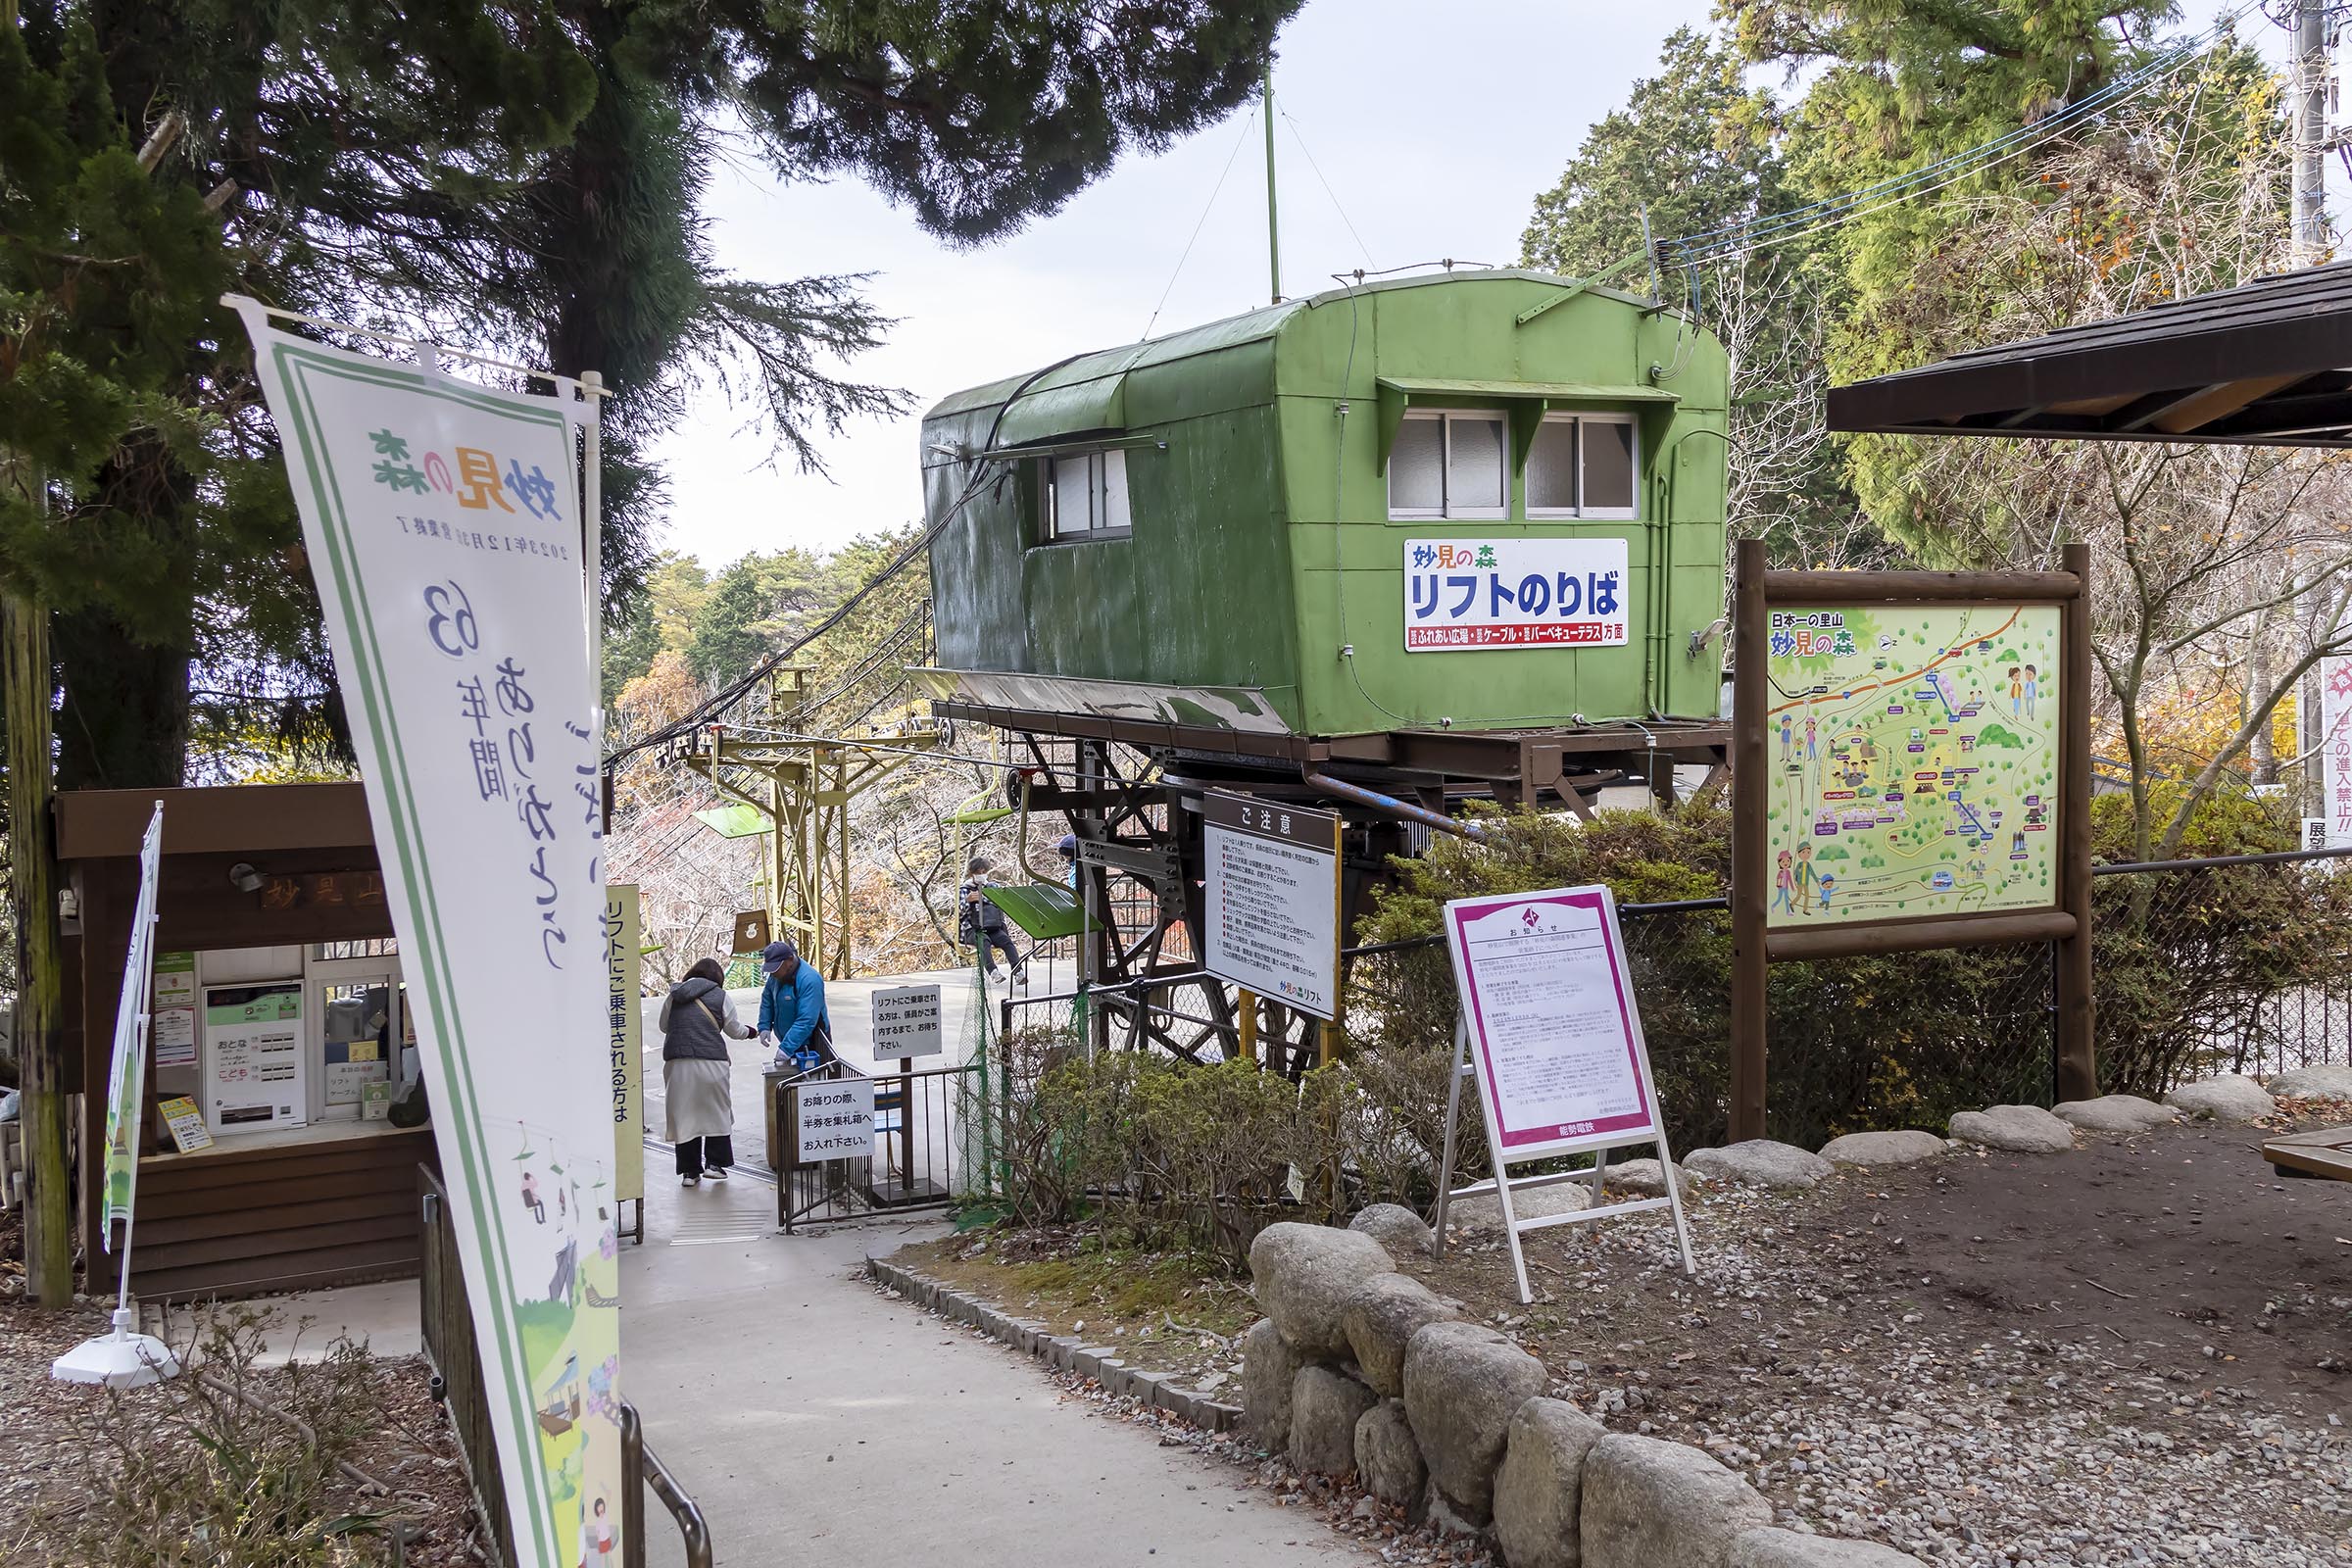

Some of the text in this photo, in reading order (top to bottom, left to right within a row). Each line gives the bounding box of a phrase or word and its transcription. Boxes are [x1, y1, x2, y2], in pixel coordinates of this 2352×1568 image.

[1413, 545, 1497, 568] 妙見の森
[1412, 570, 1619, 619] リフトのりば
[1772, 613, 1842, 627] 日本一の里山
[1770, 630, 1855, 656] 妙見の森
[1242, 807, 1291, 835] ご注意
[1510, 925, 1557, 937] お知らせ
[878, 994, 937, 1007] リフトにご乗車され
[607, 901, 628, 1123] リフトにご乗車される方は
[878, 1007, 938, 1021] る方は、係員がご案
[878, 1022, 938, 1036] 内するまで、お待ち
[804, 1113, 872, 1129] 半券を集札箱へ
[804, 1136, 867, 1151] お入れ下さい。
